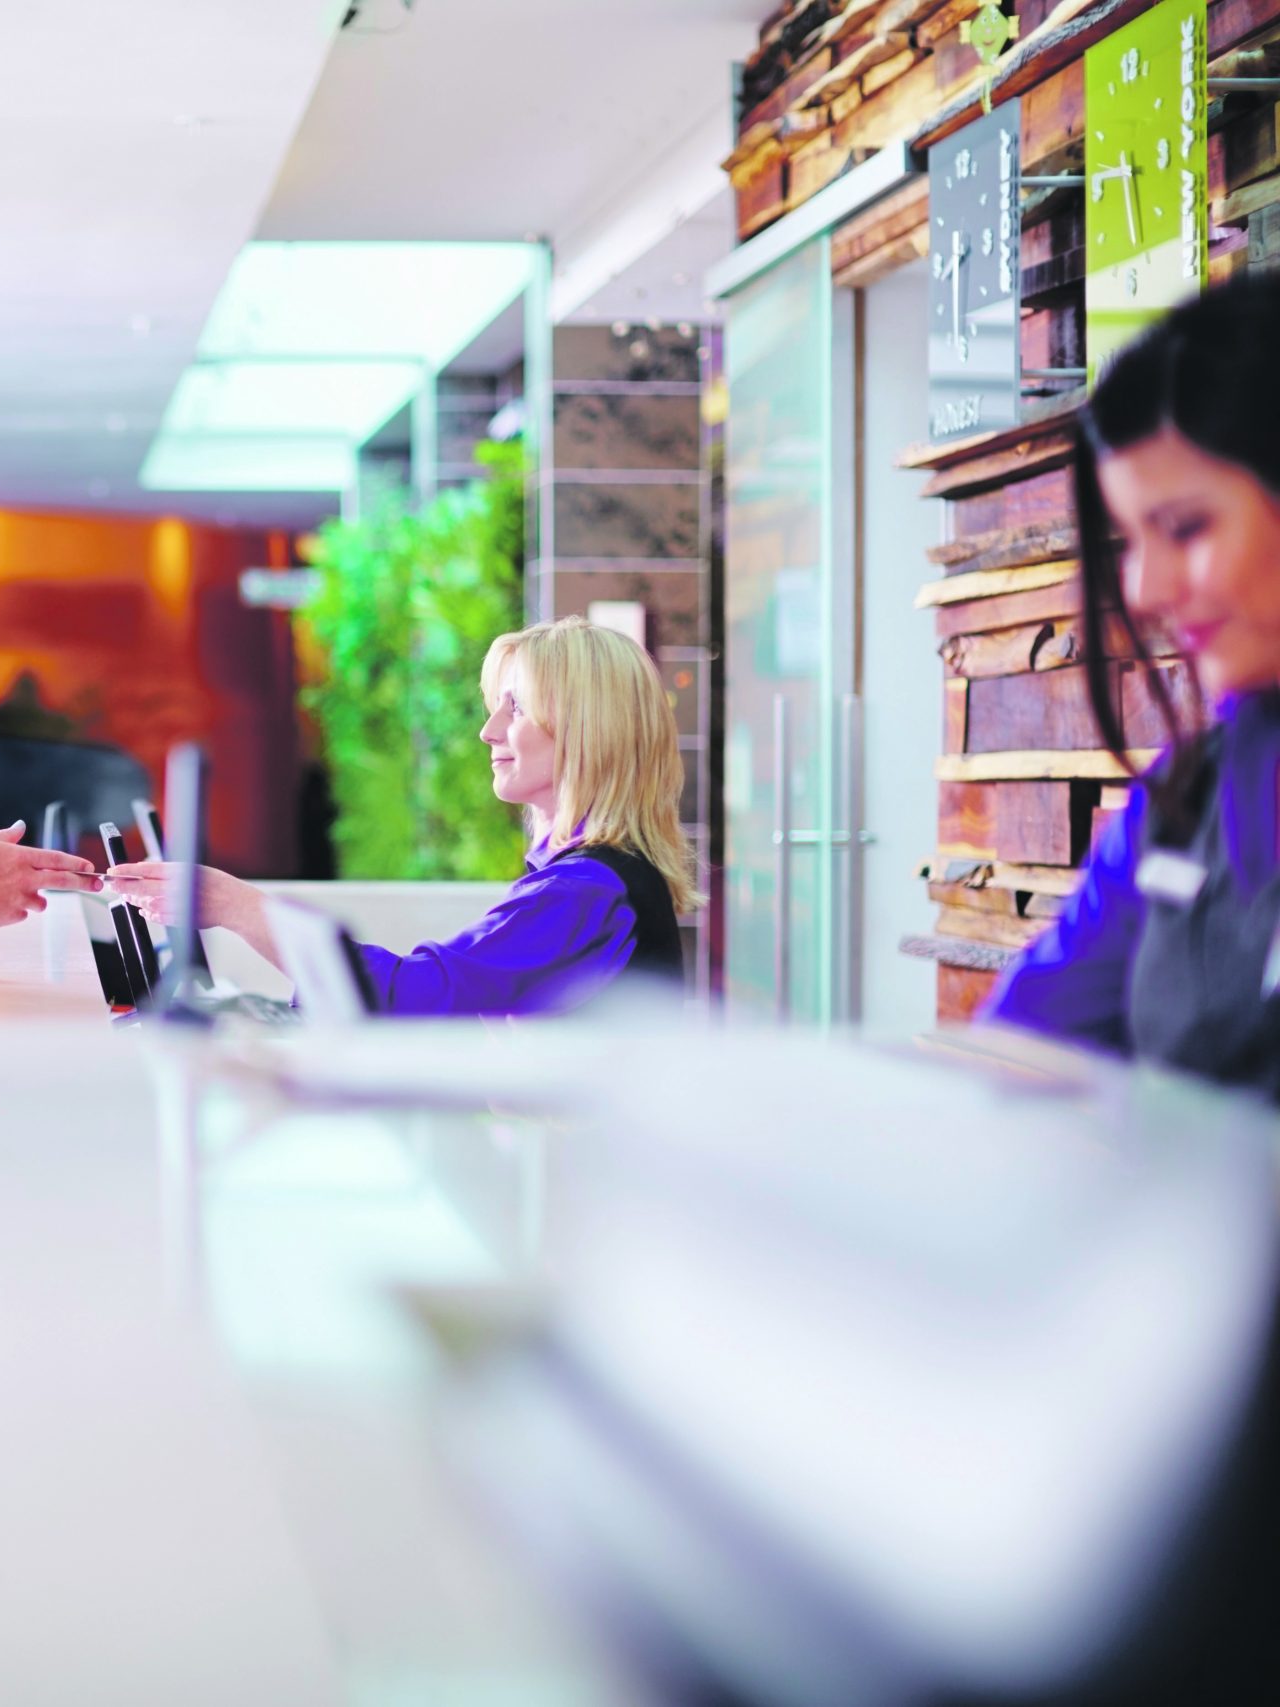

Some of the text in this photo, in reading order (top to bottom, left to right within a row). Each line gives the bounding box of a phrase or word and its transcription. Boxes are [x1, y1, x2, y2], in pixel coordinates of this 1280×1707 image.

[1121, 47, 1138, 83] 12
[1157, 137, 1169, 171] 3
[1180, 13, 1197, 279] NEW YORK
[955, 149, 970, 180] 12
[999, 128, 1012, 293] SYDNEY
[982, 228, 993, 256] 3
